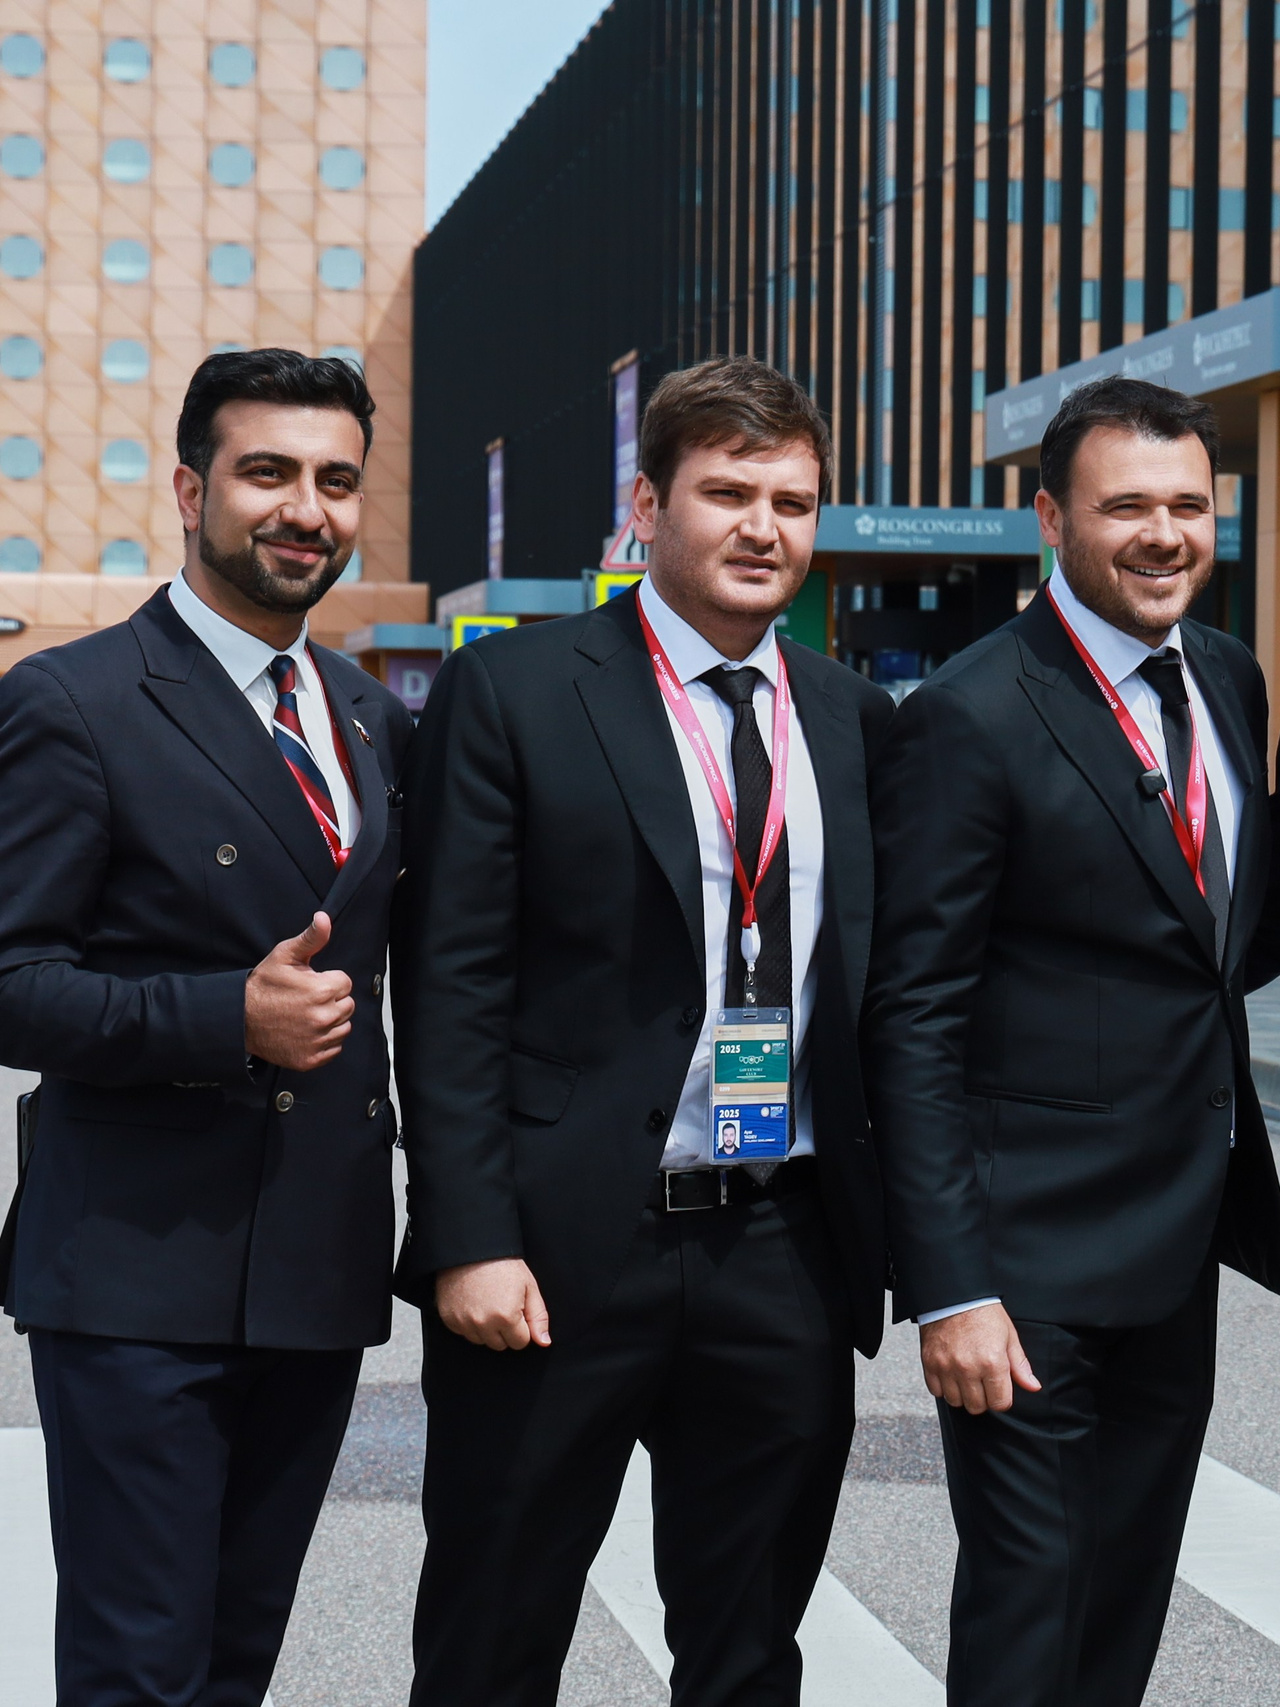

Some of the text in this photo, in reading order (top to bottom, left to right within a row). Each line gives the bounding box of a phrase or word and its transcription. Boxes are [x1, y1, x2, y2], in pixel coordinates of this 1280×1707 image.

[877, 517, 1003, 535] ROSCONGRESS
[402, 669, 430, 699] D
[720, 1044, 741, 1054] 2025
[719, 1108, 740, 1119] 2025
